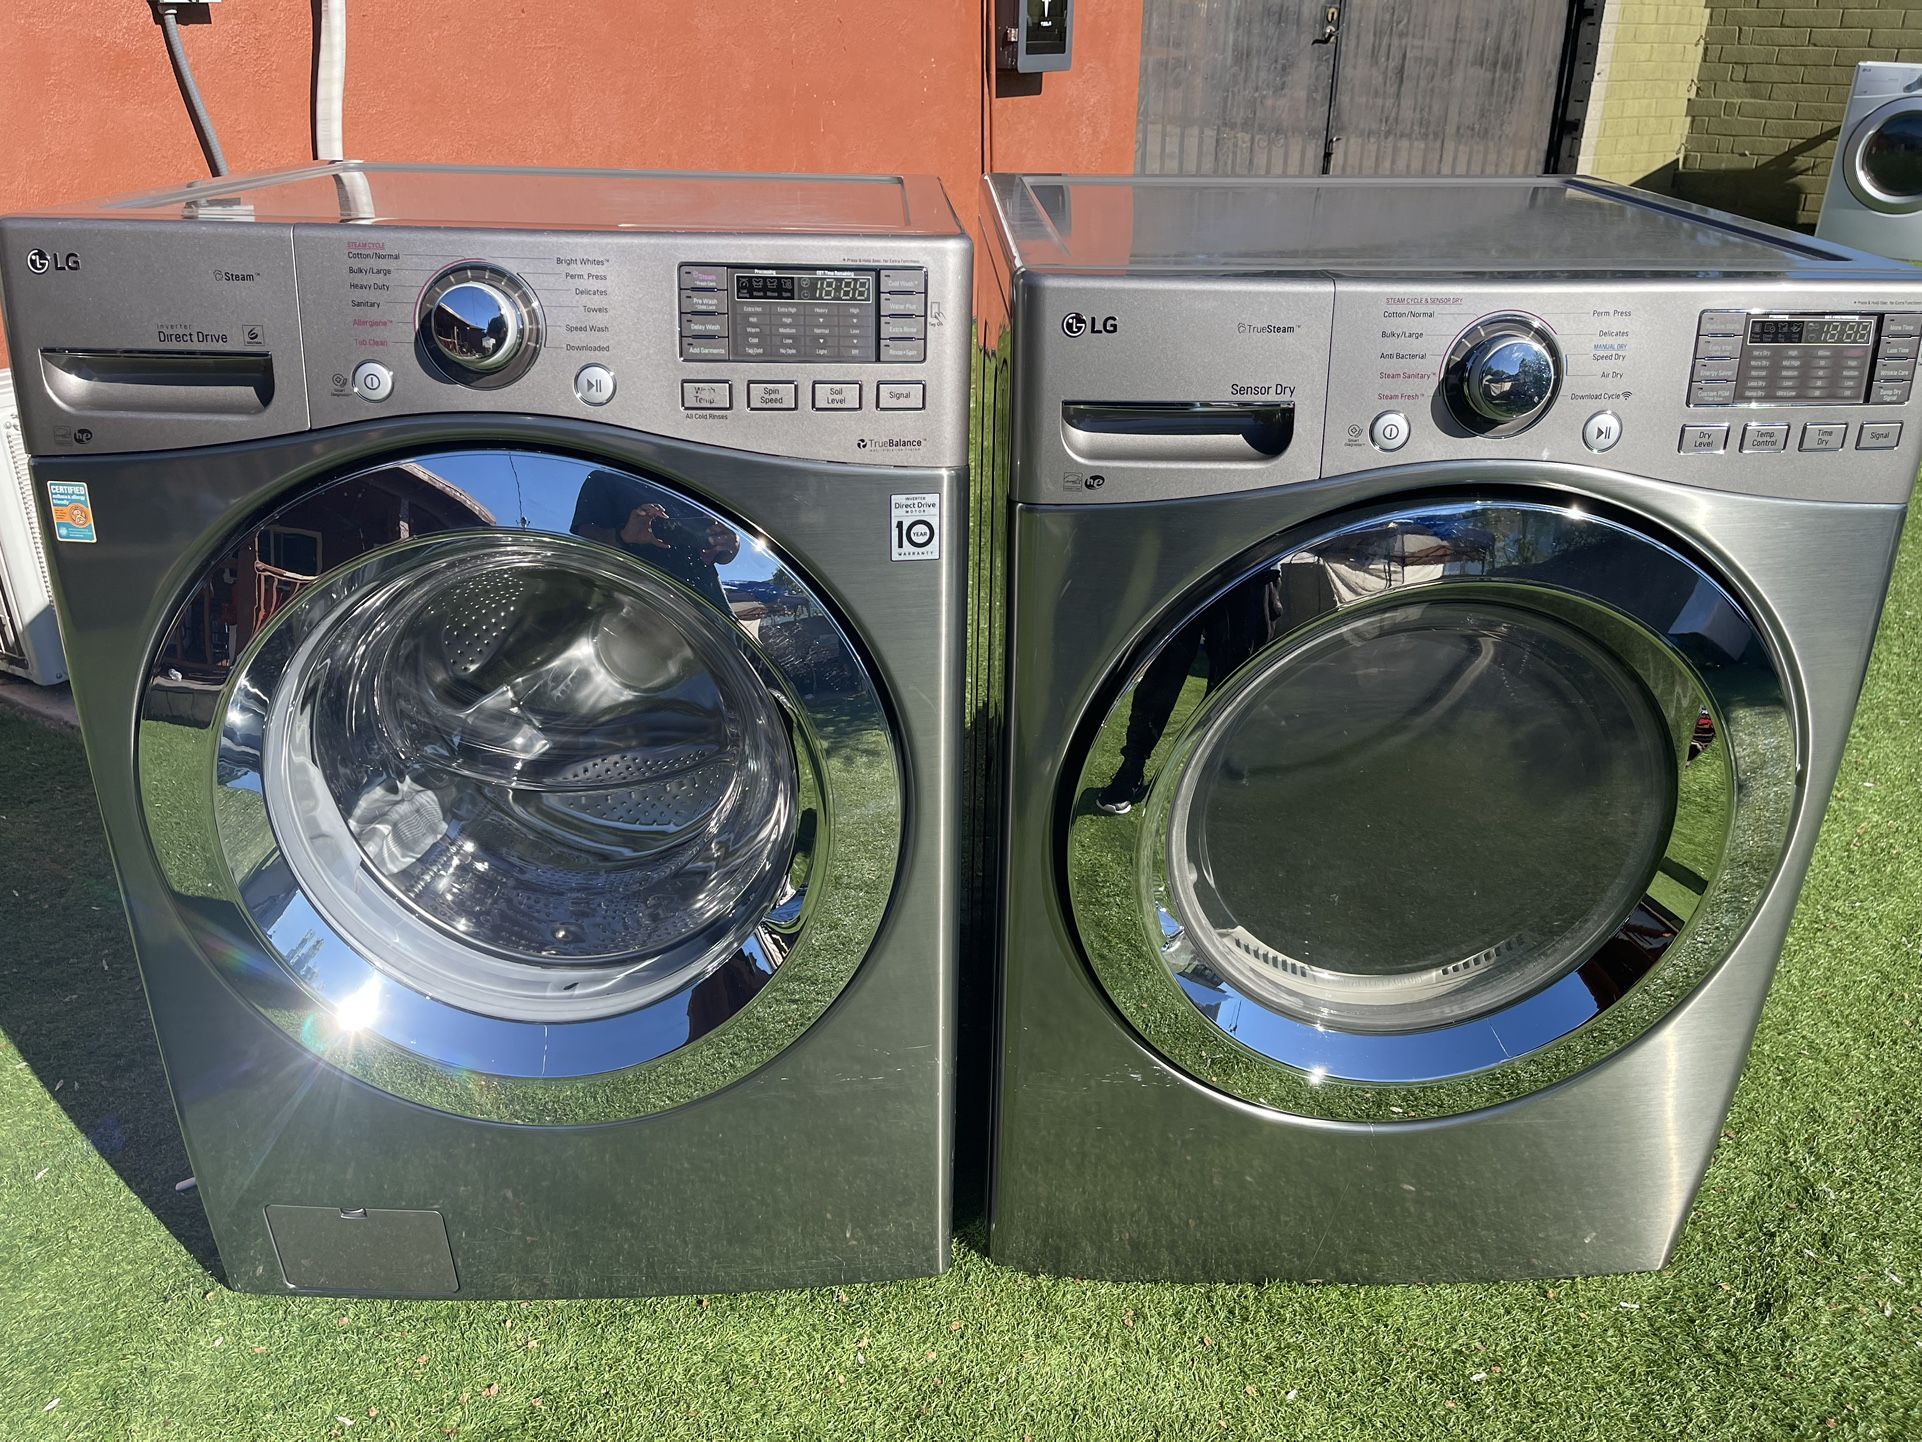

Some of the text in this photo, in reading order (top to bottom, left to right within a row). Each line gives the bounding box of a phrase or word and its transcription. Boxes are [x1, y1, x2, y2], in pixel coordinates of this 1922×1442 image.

[348, 252, 400, 260] Cotton/Normal
[53, 252, 81, 271] LG
[556, 257, 578, 266] Bright
[348, 266, 392, 276] Bulky/Large
[350, 282, 390, 292] Heavy Duty
[575, 288, 608, 296] Delicates
[352, 300, 380, 308] Sanitary
[1383, 310, 1434, 318] Cotton/Normal
[566, 324, 609, 333] Speed Wash
[1090, 316, 1118, 334] LG
[158, 331, 228, 343] Direct Drive
[1381, 330, 1424, 340] Bulky/Large
[566, 344, 610, 352] Downloaded
[1592, 354, 1612, 362] Speed
[1380, 372, 1401, 380] Steam
[1612, 372, 1624, 380] Dry
[764, 387, 780, 396] Spin
[1231, 384, 1296, 398] Sensor Dry
[889, 391, 910, 400] Signal
[1603, 393, 1620, 401] Cycle
[760, 396, 783, 405] Speed
[826, 396, 846, 404] Level
[1699, 431, 1712, 440] Dry
[1870, 432, 1890, 440] Signal
[1694, 440, 1714, 448] Level
[1752, 439, 1778, 447] Control
[1817, 438, 1829, 446] Dry
[50, 486, 84, 494] CERTIFIED
[896, 520, 934, 548] 10
